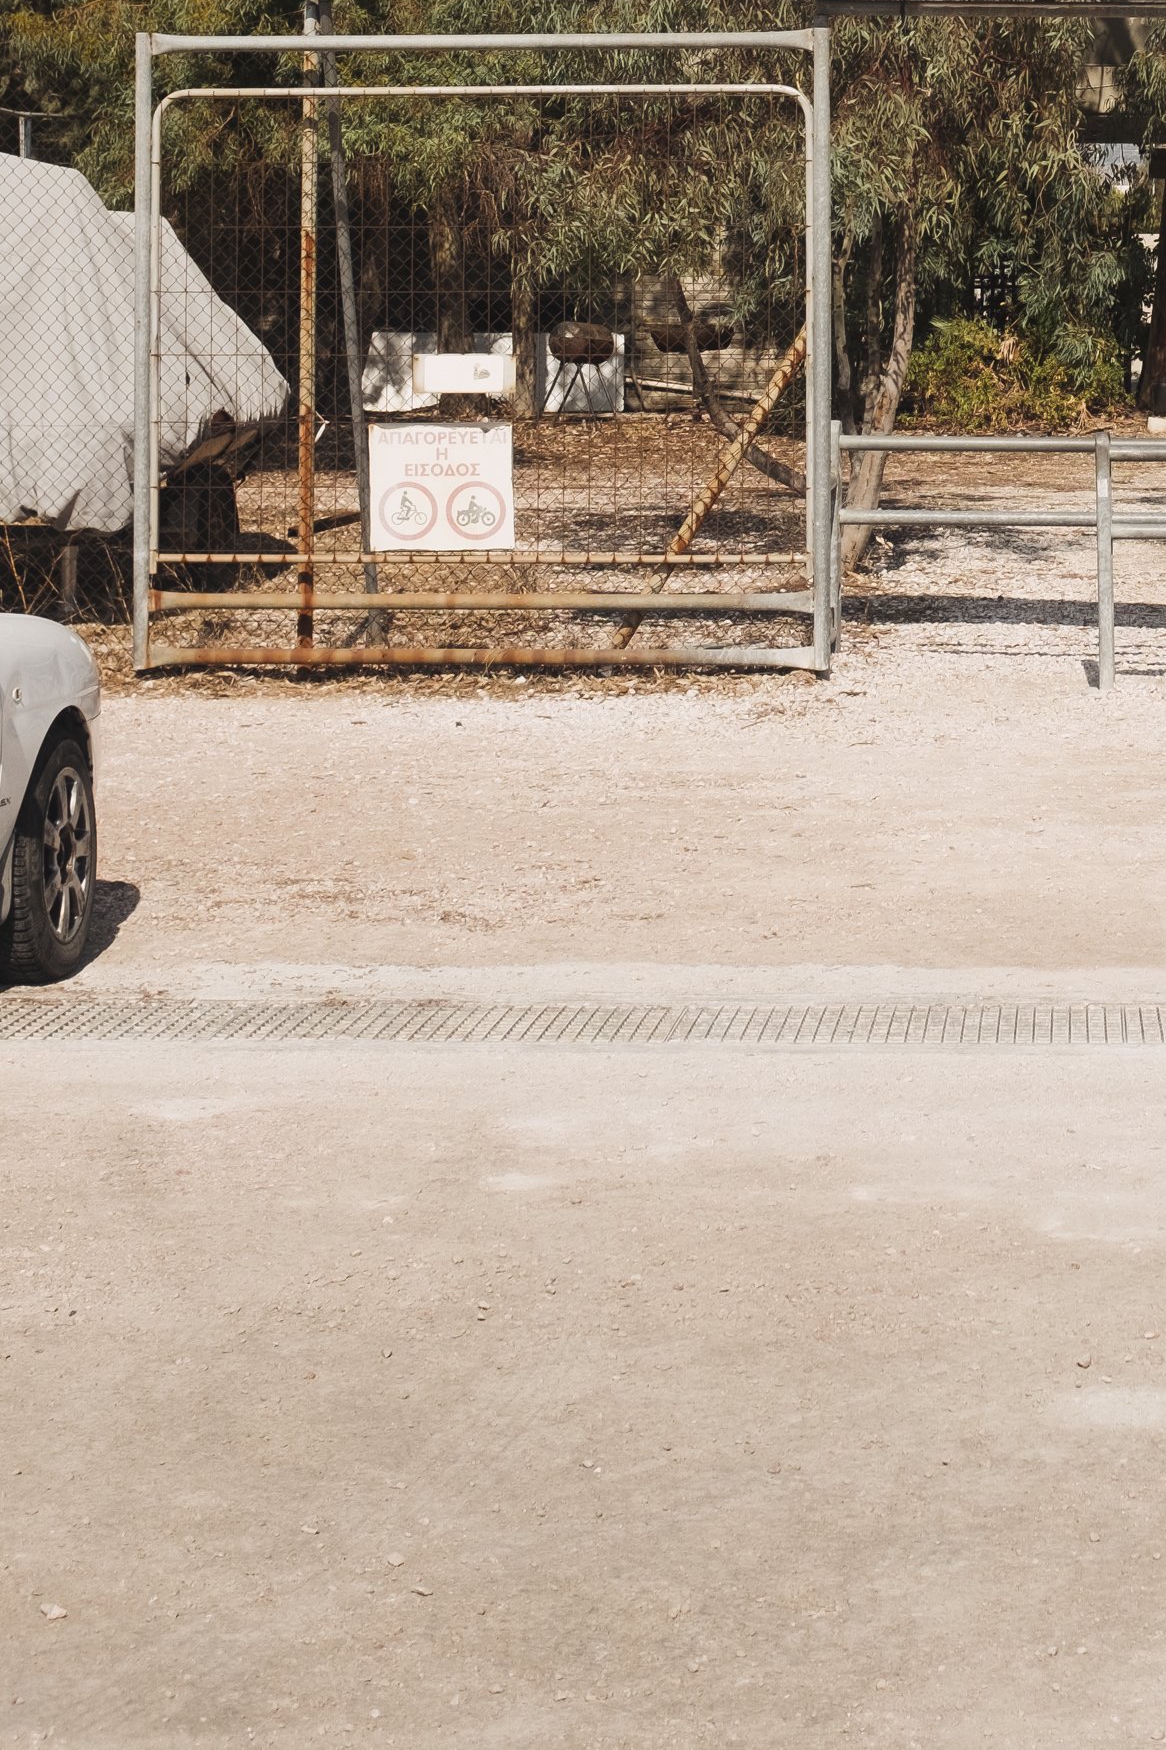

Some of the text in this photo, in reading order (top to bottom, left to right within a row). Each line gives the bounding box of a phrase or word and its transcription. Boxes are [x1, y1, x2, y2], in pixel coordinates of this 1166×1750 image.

[378, 431, 507, 445] ΑΠΑΓΟΡΕΥΕΤΑΙ
[436, 447, 449, 461] Η
[404, 463, 481, 477] ΕΙΣΟΔΟΣ
